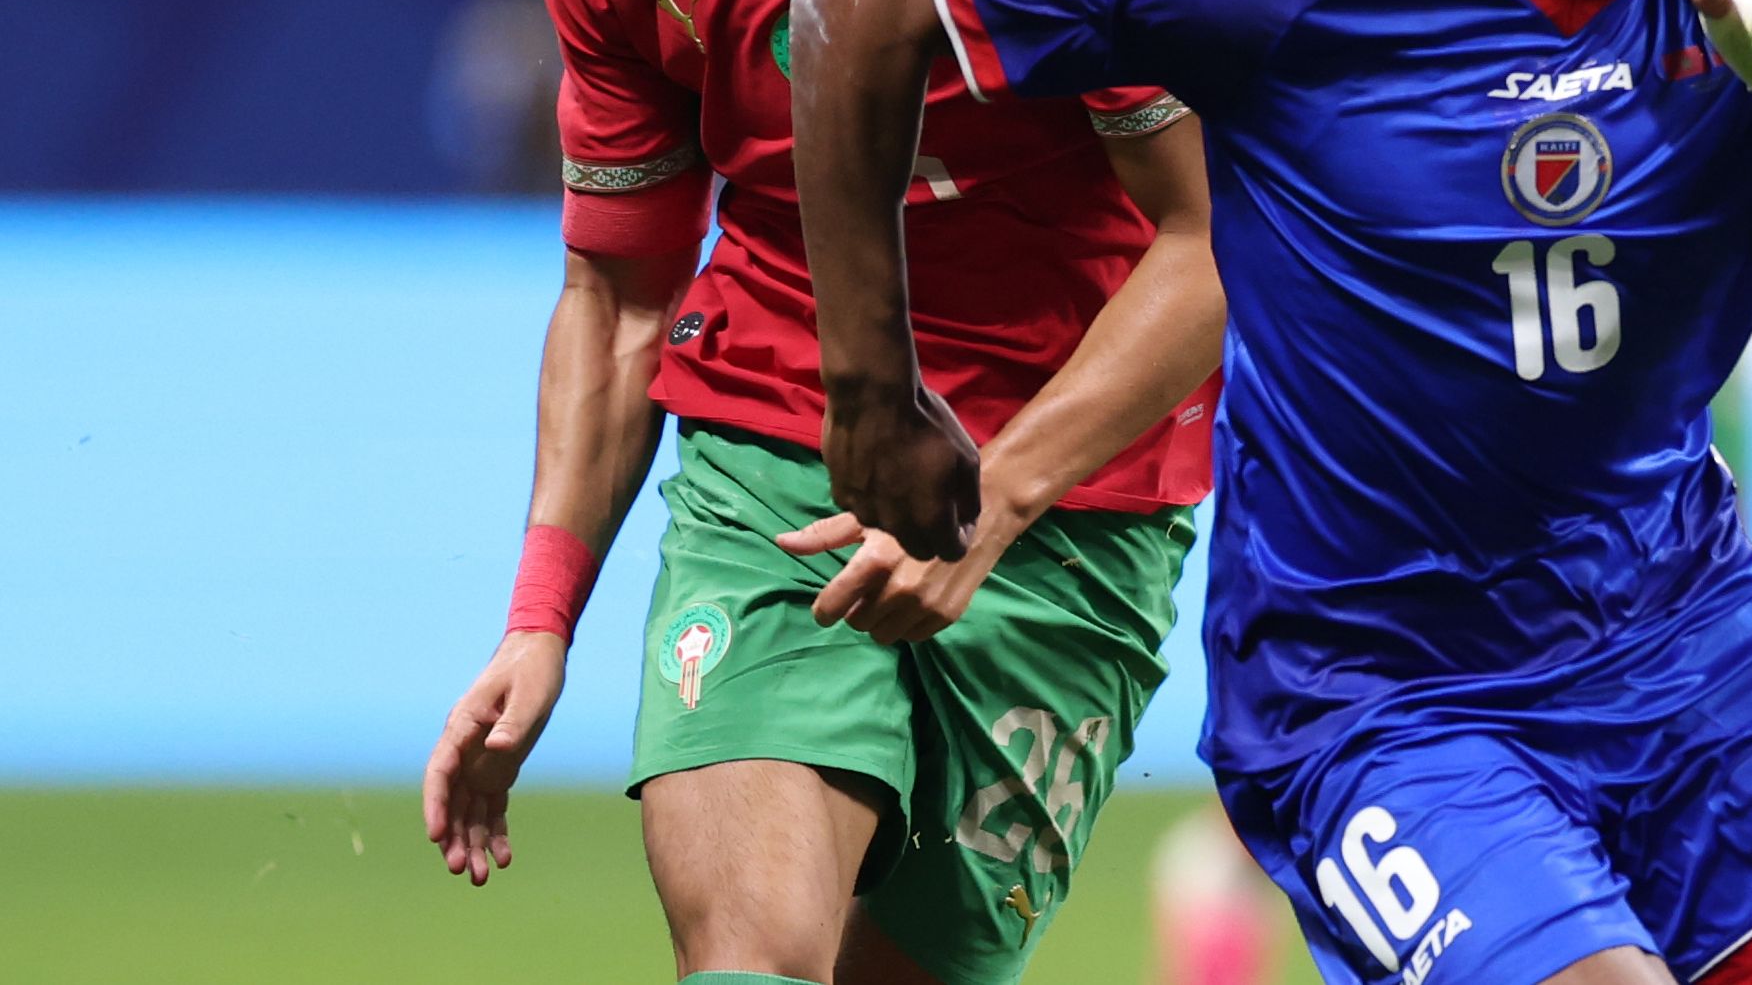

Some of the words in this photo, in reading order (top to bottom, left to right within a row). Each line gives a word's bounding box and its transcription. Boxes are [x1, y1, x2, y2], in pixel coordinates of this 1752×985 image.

[1489, 63, 1633, 101] SAETA
[1540, 142, 1576, 152] HAITI
[1492, 233, 1621, 381] 16
[956, 706, 1109, 873] 26
[1316, 806, 1440, 973] 16
[1400, 908, 1472, 985] AETA
